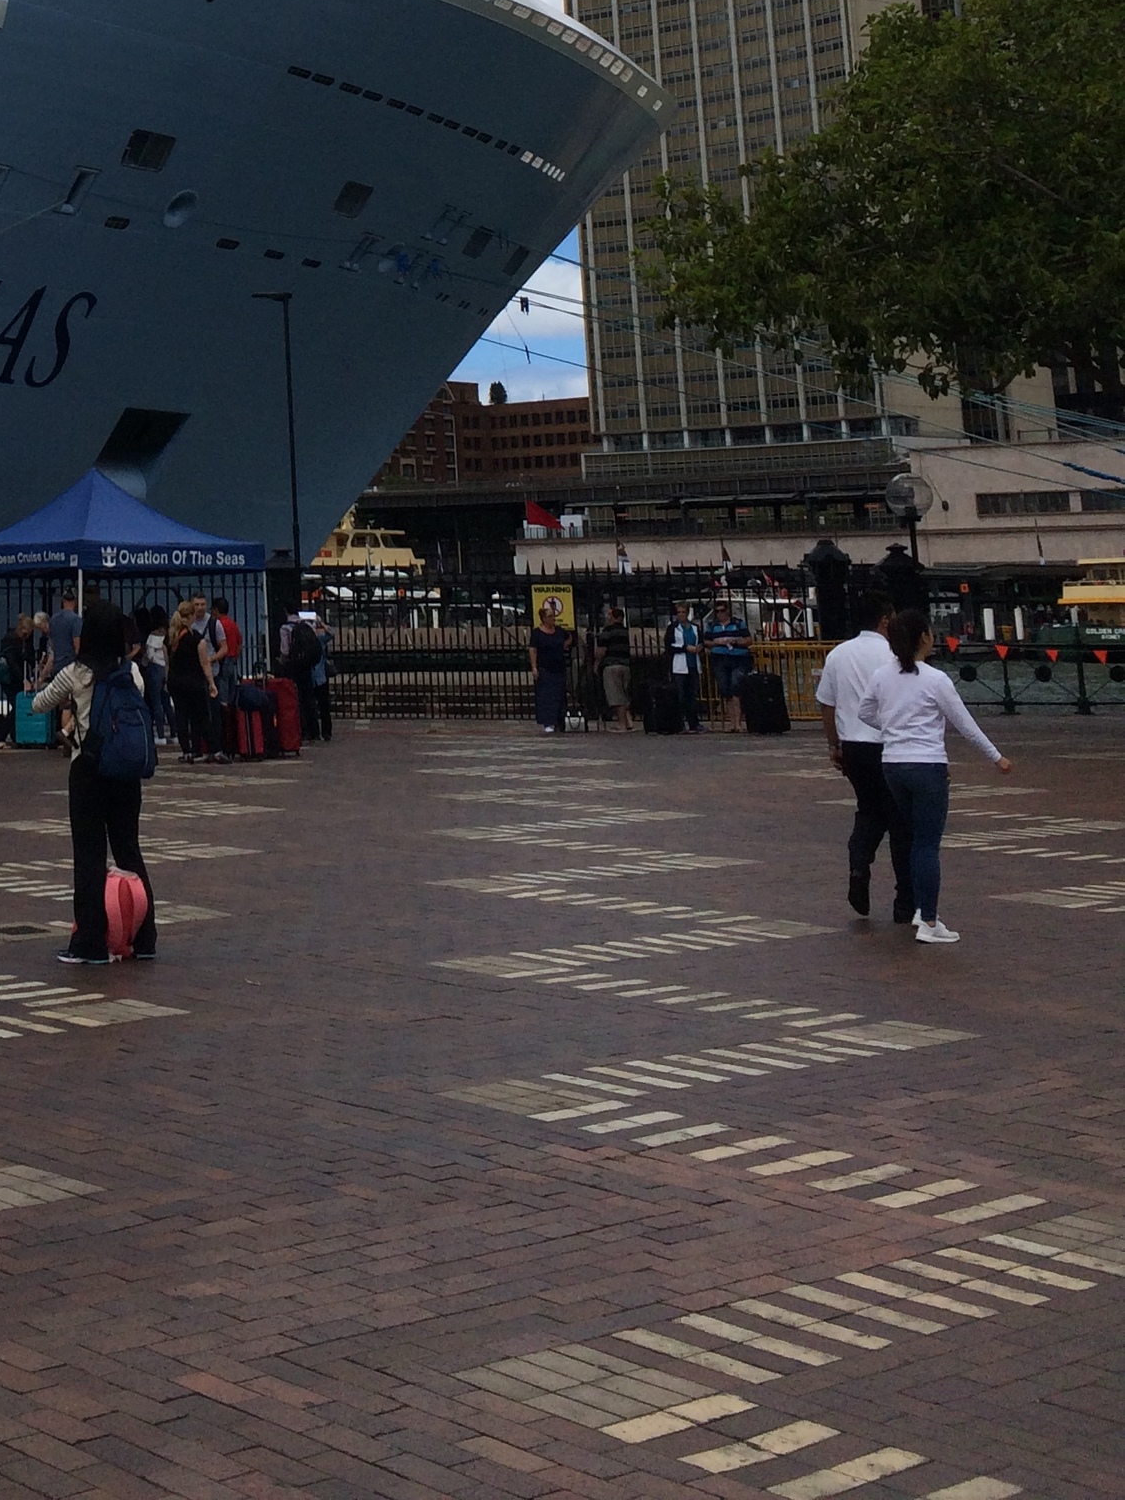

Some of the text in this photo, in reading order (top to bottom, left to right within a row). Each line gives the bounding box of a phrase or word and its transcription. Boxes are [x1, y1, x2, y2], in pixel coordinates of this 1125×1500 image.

[17, 551, 42, 564] Cruise
[43, 550, 65, 562] Lines
[119, 549, 245, 566] Ovation Of The Seas
